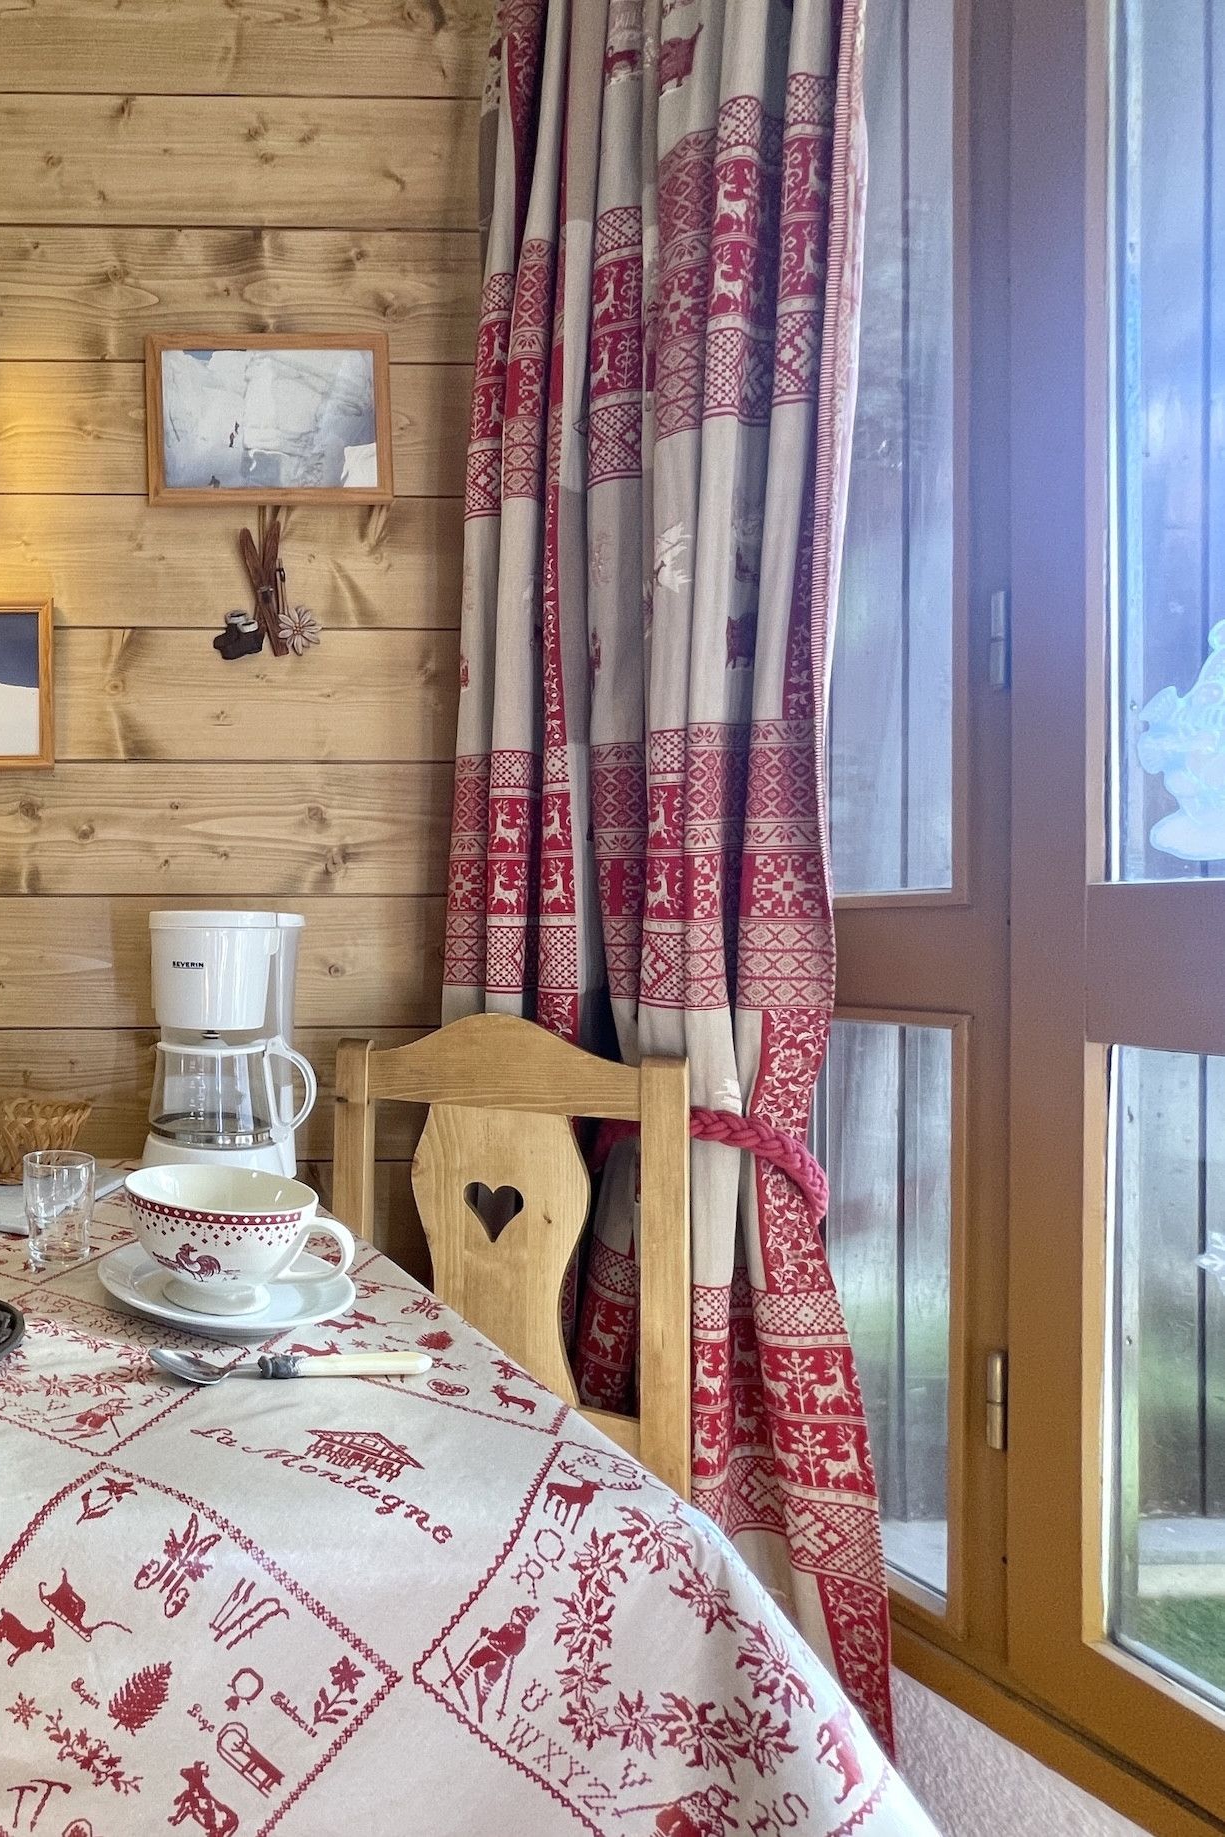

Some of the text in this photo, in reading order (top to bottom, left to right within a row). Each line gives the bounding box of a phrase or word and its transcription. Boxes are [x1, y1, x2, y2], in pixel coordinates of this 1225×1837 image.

[172, 960, 204, 968] SEVERIN
[190, 1428, 453, 1544] La Montagne
